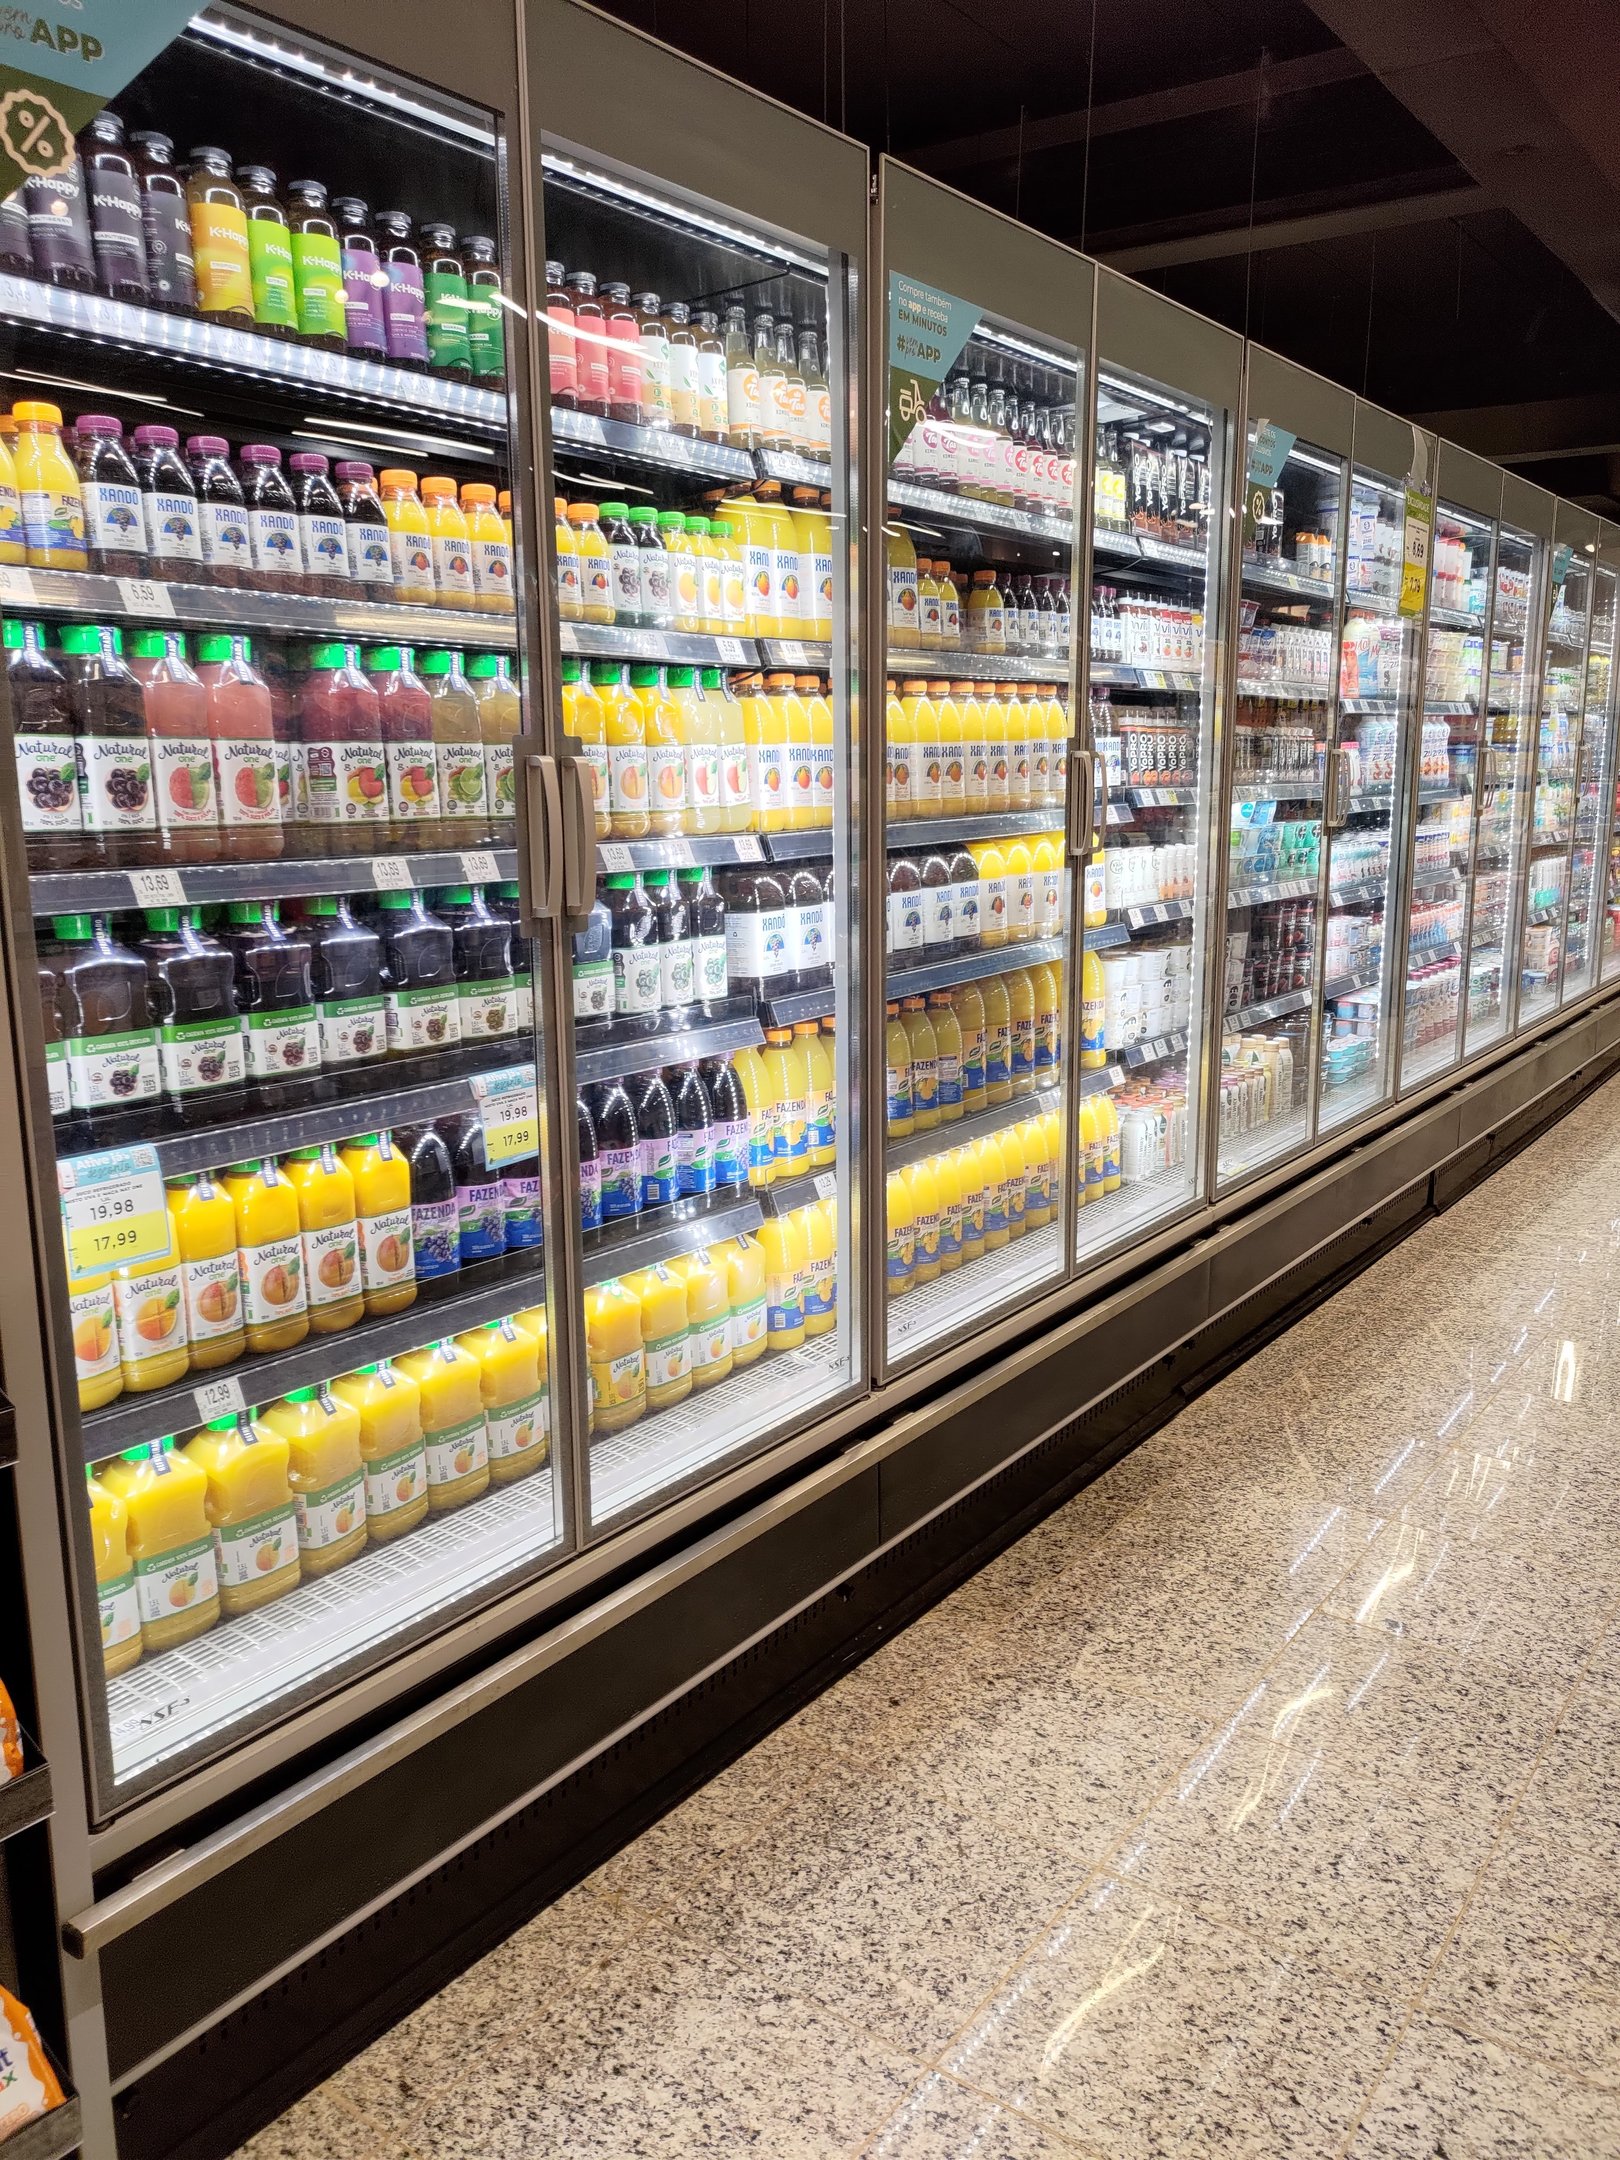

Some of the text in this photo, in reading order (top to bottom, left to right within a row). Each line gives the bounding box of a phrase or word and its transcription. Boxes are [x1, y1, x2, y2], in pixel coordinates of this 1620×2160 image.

[30, 18, 105, 63] APP
[898, 280, 952, 311] Compre também
[898, 296, 908, 307] no
[908, 300, 922, 314] app
[927, 308, 948, 323] receba
[898, 309, 948, 337] EM MINUTOS
[131, 584, 155, 602] 6,59
[15, 740, 74, 758] Natural
[94, 742, 147, 760] Natural
[158, 742, 209, 760] Natural
[225, 743, 274, 760] Natural
[341, 746, 383, 762] Natural
[394, 746, 433, 761] Natural
[443, 746, 482, 761] Natural
[583, 750, 606, 761] atural
[615, 749, 647, 761] Natural
[653, 749, 683, 761] Natural
[377, 862, 400, 877] 13,69
[467, 857, 489, 871] 13,69
[141, 874, 170, 892] 13,69
[629, 951, 658, 964] Natural
[276, 1027, 306, 1040] Natural
[191, 1040, 226, 1054] Natural
[102, 1053, 142, 1068] Natural
[500, 1106, 527, 1122] 19,98
[503, 1131, 529, 1147] 17,99
[90, 1199, 134, 1220] 19,98
[370, 1215, 409, 1235] Natural
[94, 1230, 137, 1251] 17,99
[311, 1226, 355, 1249] Natural
[254, 1243, 298, 1266] Natural
[190, 1259, 236, 1281] Natural
[125, 1274, 178, 1299] Natural
[613, 1355, 640, 1374] Natural
[204, 1384, 231, 1405] 12,99
[449, 1435, 476, 1454] Natural
[250, 1527, 282, 1548] Natural
[162, 1562, 199, 1584] Natural
